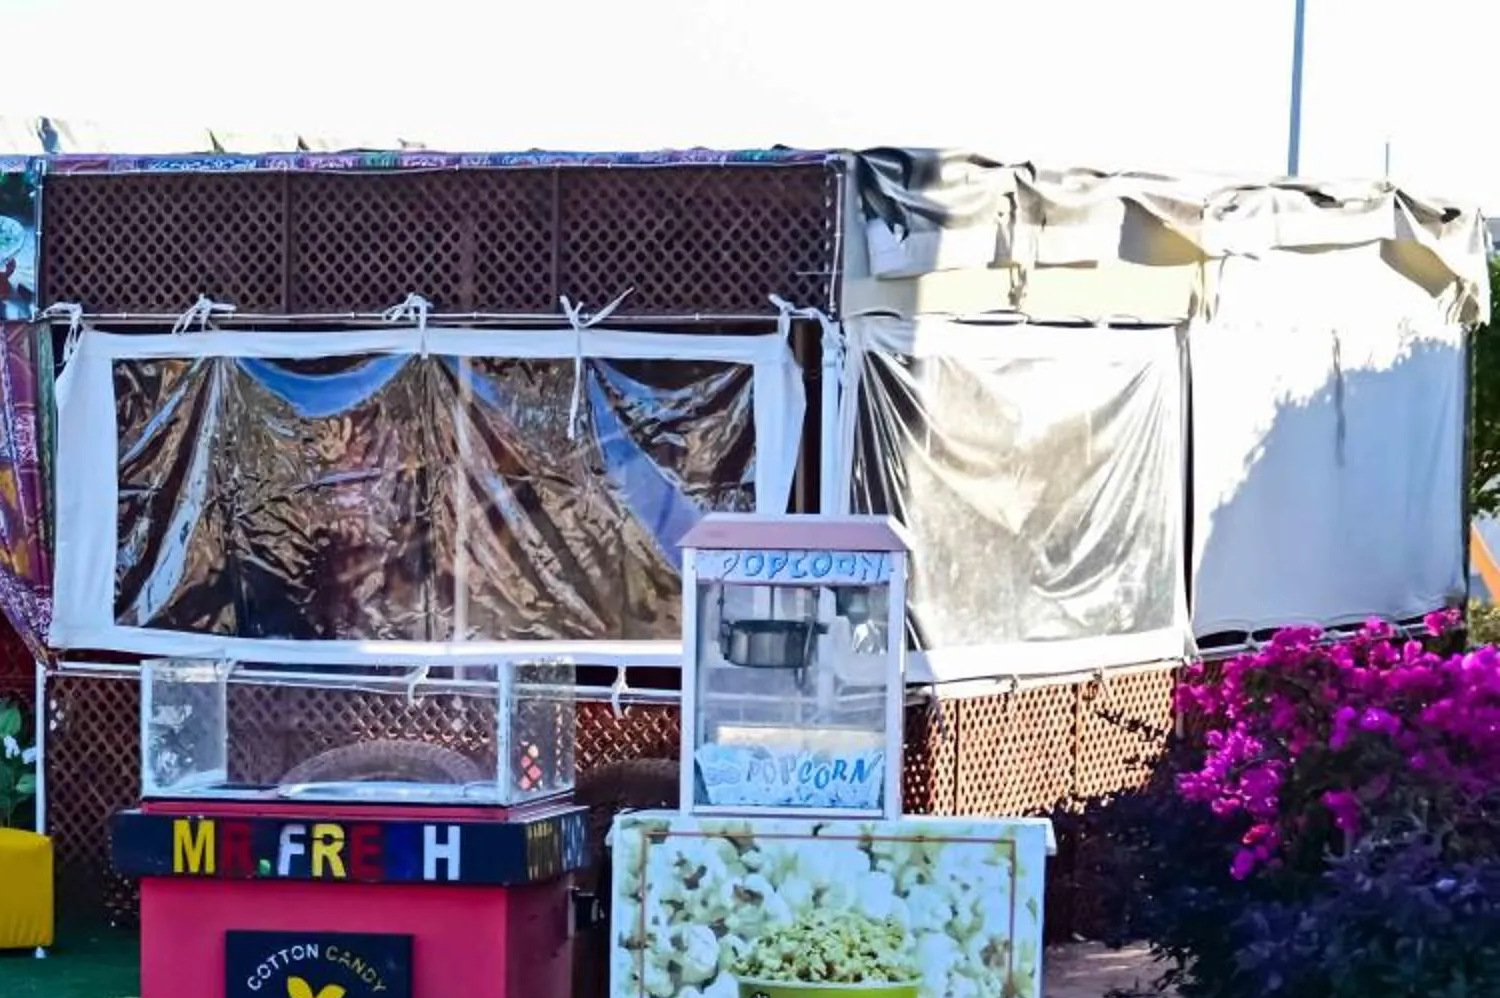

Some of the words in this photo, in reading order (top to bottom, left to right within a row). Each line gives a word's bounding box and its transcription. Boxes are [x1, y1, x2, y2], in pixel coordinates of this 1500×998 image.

[746, 752, 882, 789] POPCORN
[172, 818, 462, 881] MR.FREH
[247, 943, 319, 991] COTTON
[325, 945, 386, 992] CANDY
